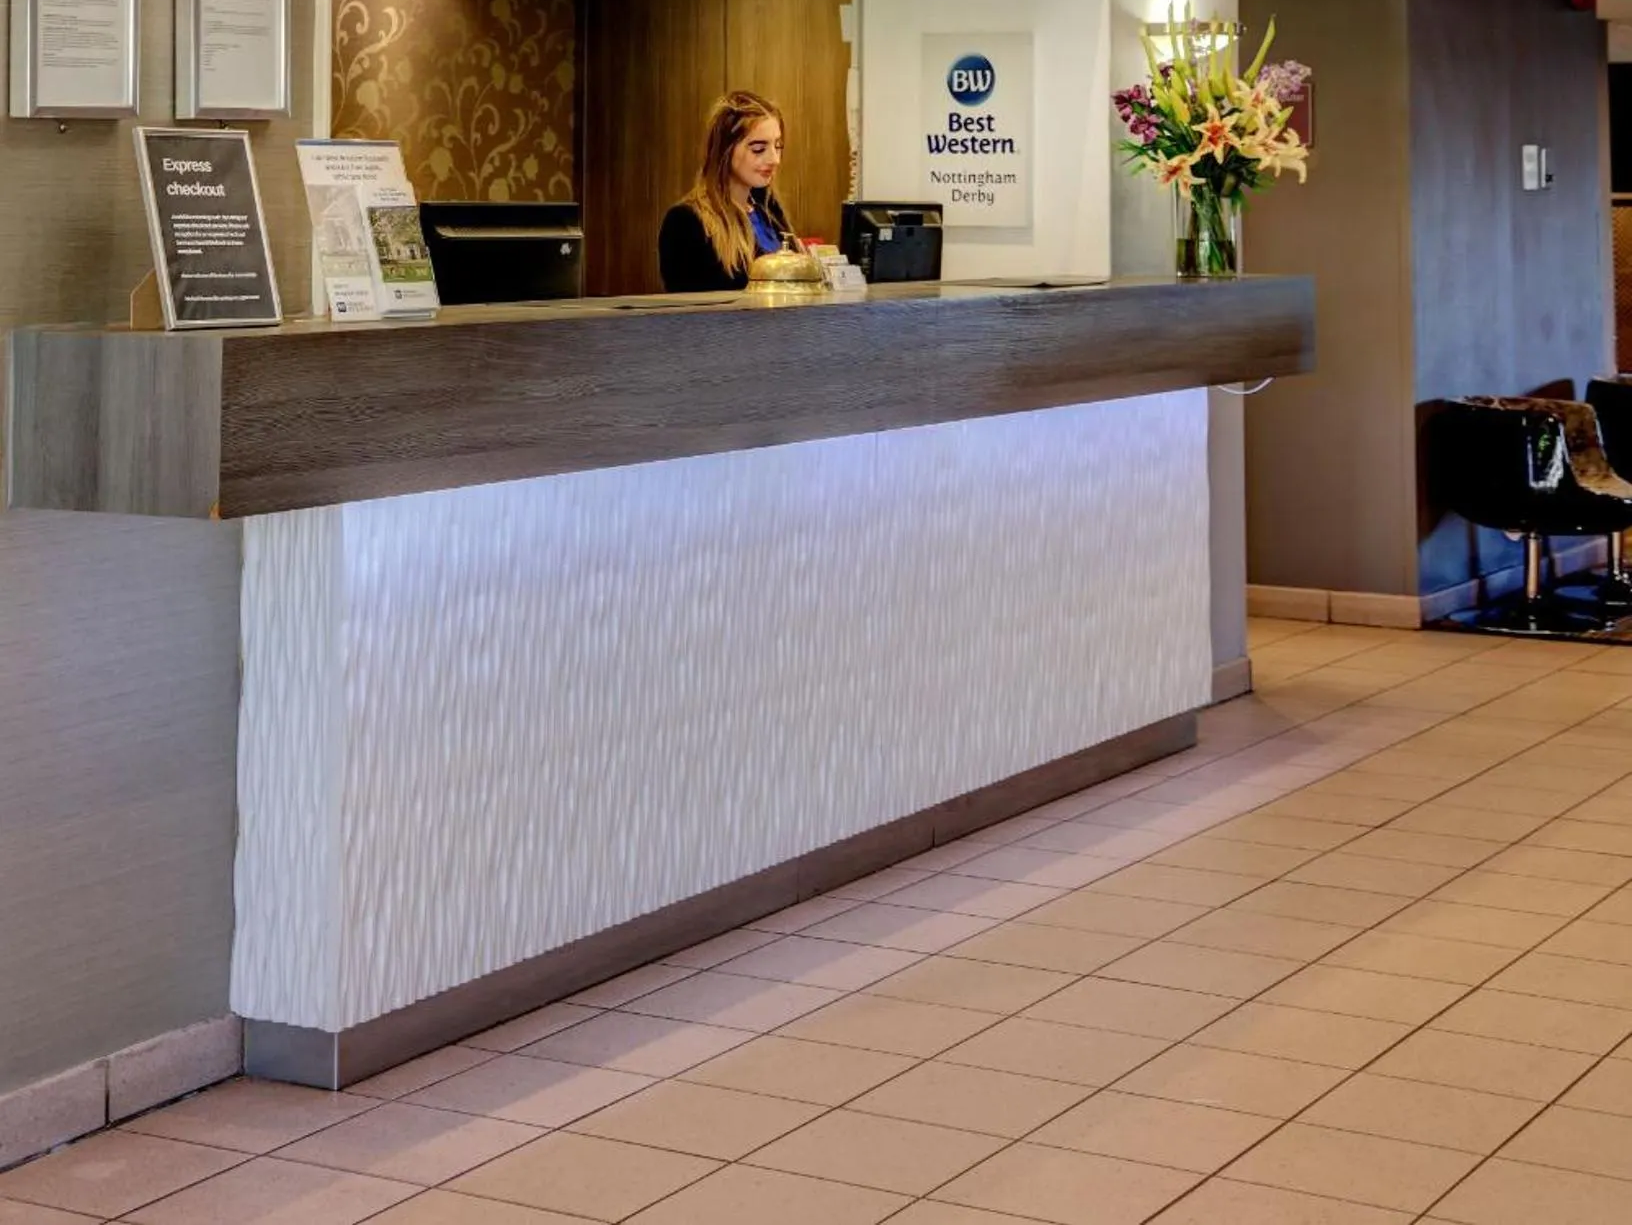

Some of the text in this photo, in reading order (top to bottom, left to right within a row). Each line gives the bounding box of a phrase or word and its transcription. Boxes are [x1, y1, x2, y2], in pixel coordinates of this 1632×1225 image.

[952, 69, 992, 93] BW
[948, 112, 995, 133] Best
[927, 134, 1015, 155] Western
[162, 157, 212, 175] Express
[930, 170, 1017, 187] Nottingham
[166, 180, 225, 197] checkout
[951, 188, 995, 206] Derby
